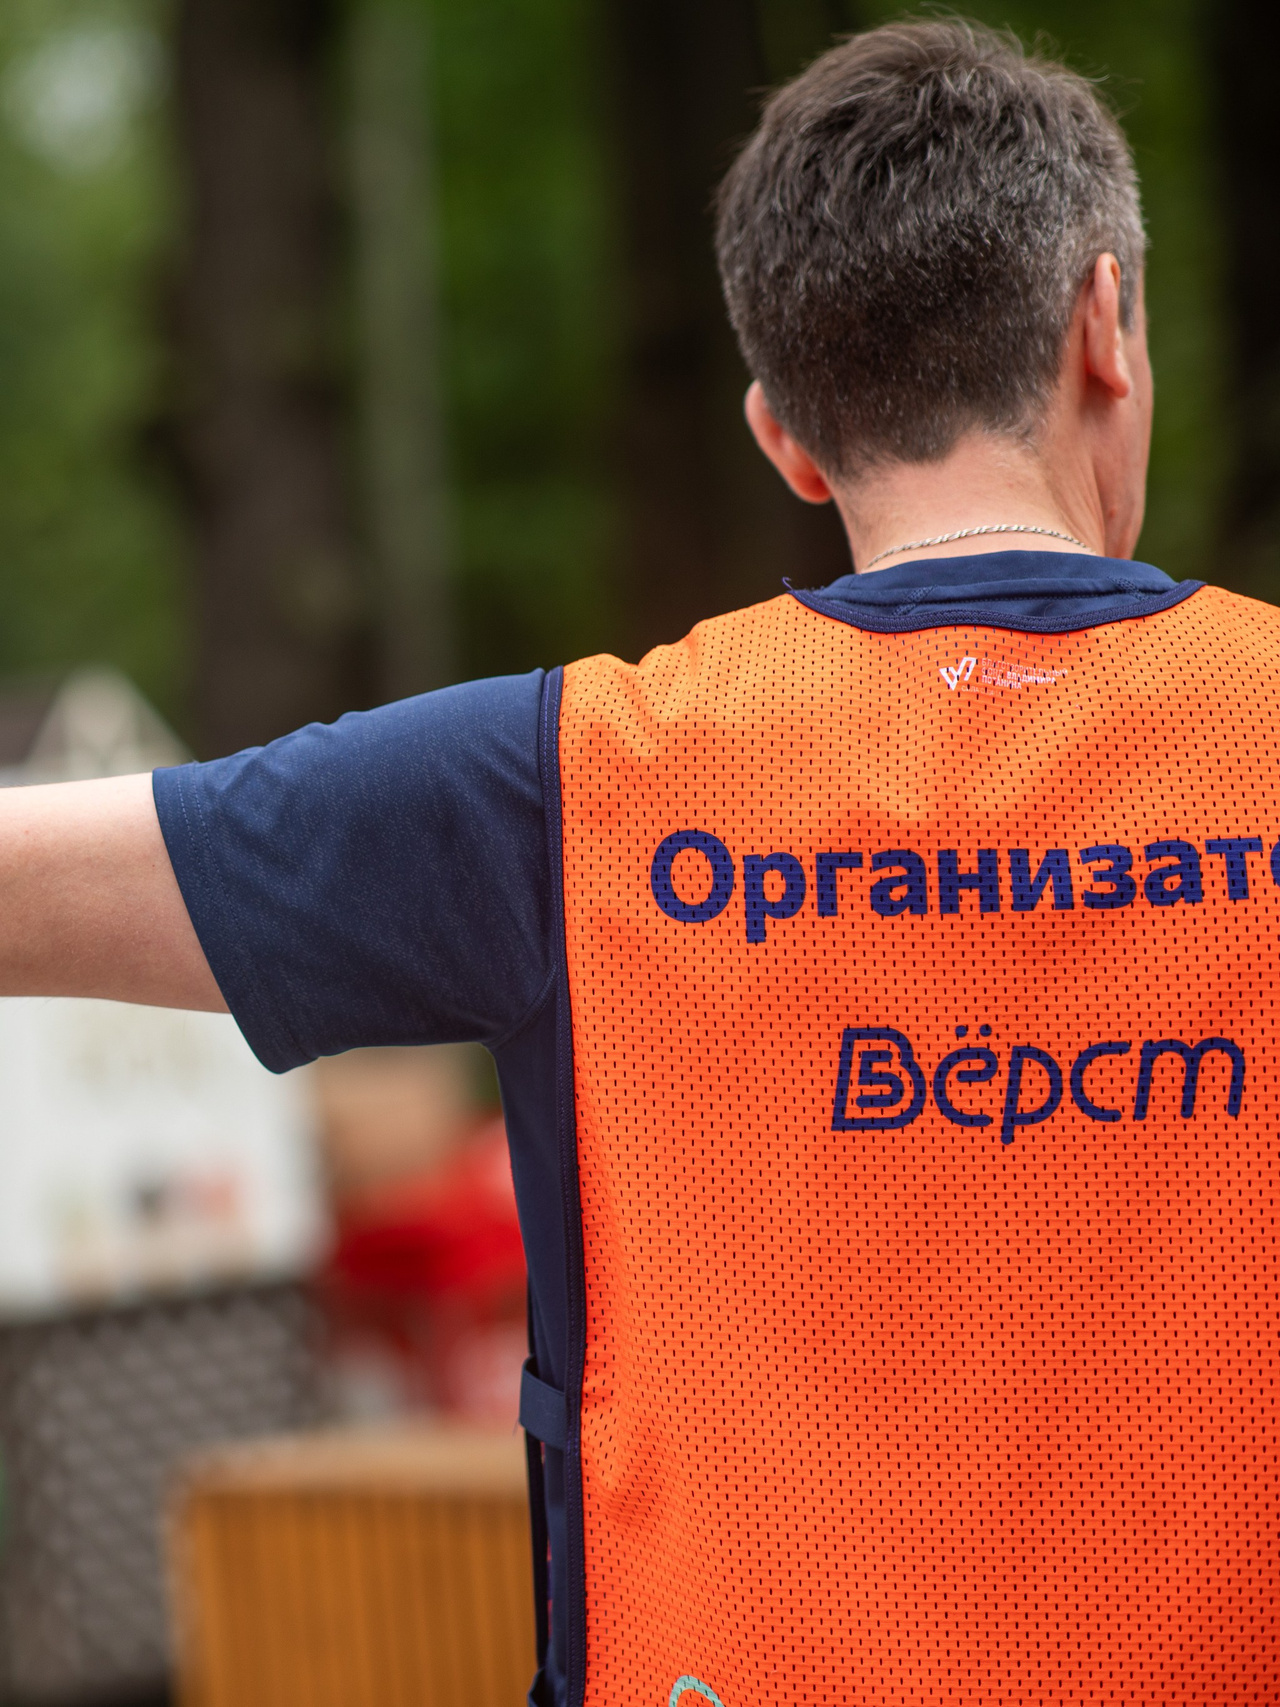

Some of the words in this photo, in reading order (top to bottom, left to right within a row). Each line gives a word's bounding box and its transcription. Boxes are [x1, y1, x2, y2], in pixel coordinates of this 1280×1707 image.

[981, 675, 1022, 690] ПОТАНИНА
[1006, 670, 1057, 685] ВЛАДИМИРА
[651, 828, 1280, 944] Организат
